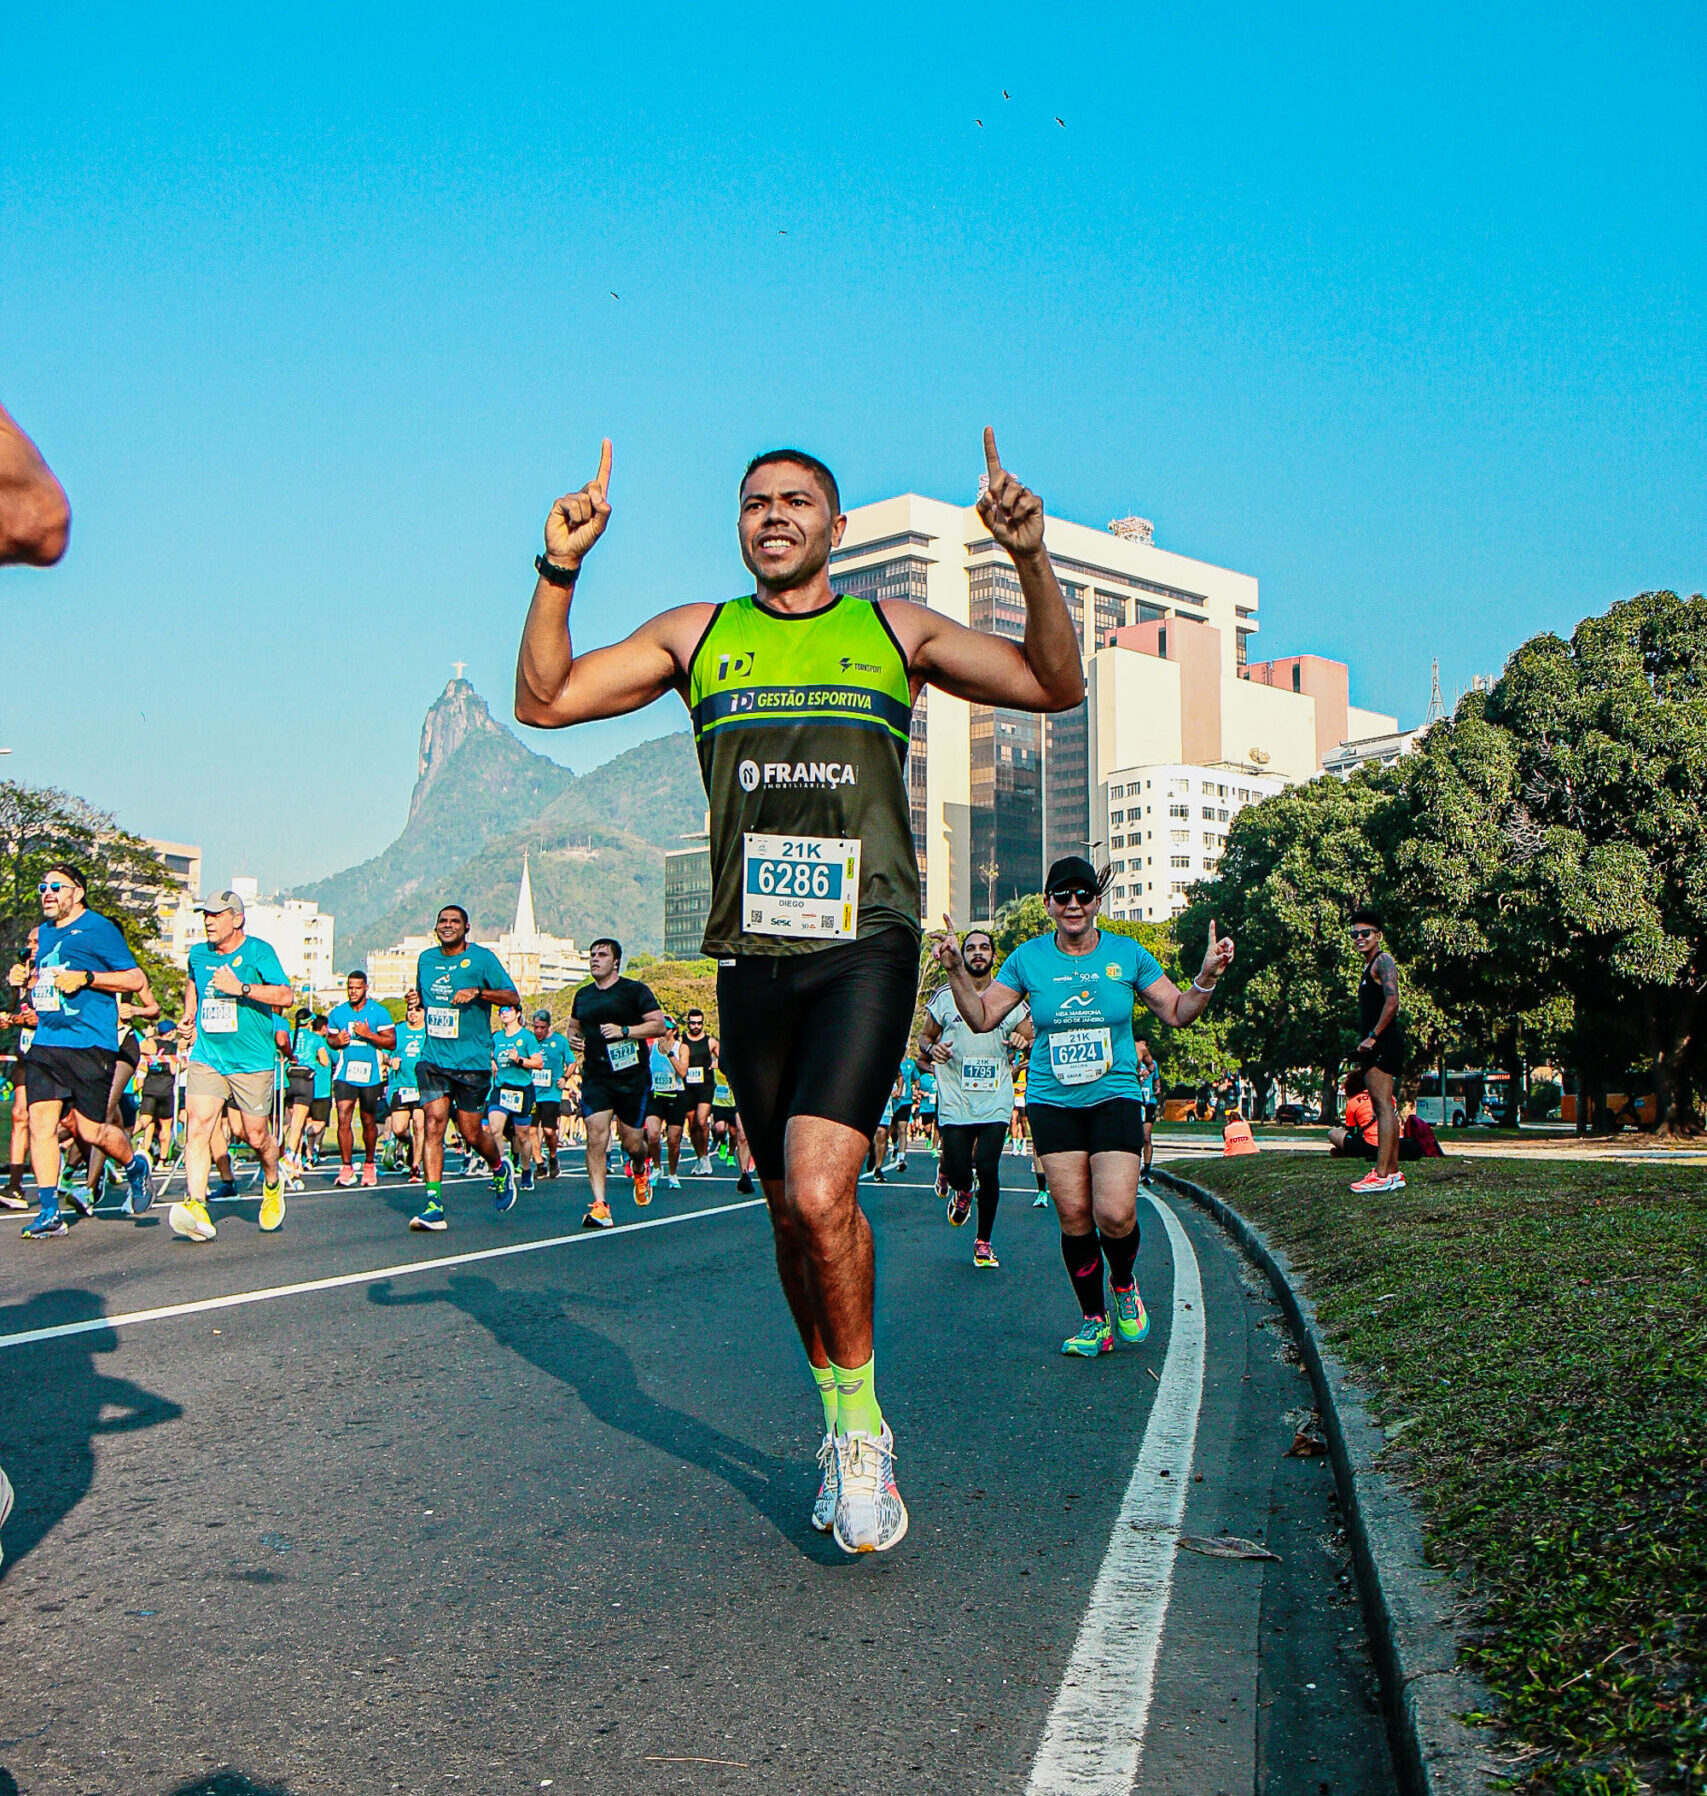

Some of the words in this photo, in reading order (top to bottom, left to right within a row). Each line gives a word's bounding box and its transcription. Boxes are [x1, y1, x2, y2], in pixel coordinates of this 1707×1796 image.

[757, 689, 805, 707] GESTÃO
[807, 691, 872, 709] ESPORTIVA
[764, 762, 856, 790] FRANÇA
[782, 841, 822, 859] 21K
[758, 861, 830, 898] 6286
[778, 900, 805, 908] DIEGO
[431, 1015, 450, 1026] 3730
[1070, 1033, 1090, 1042] 21K
[613, 1045, 632, 1059] 5727
[1059, 1043, 1097, 1063] 6224
[968, 1066, 992, 1078] 1795
